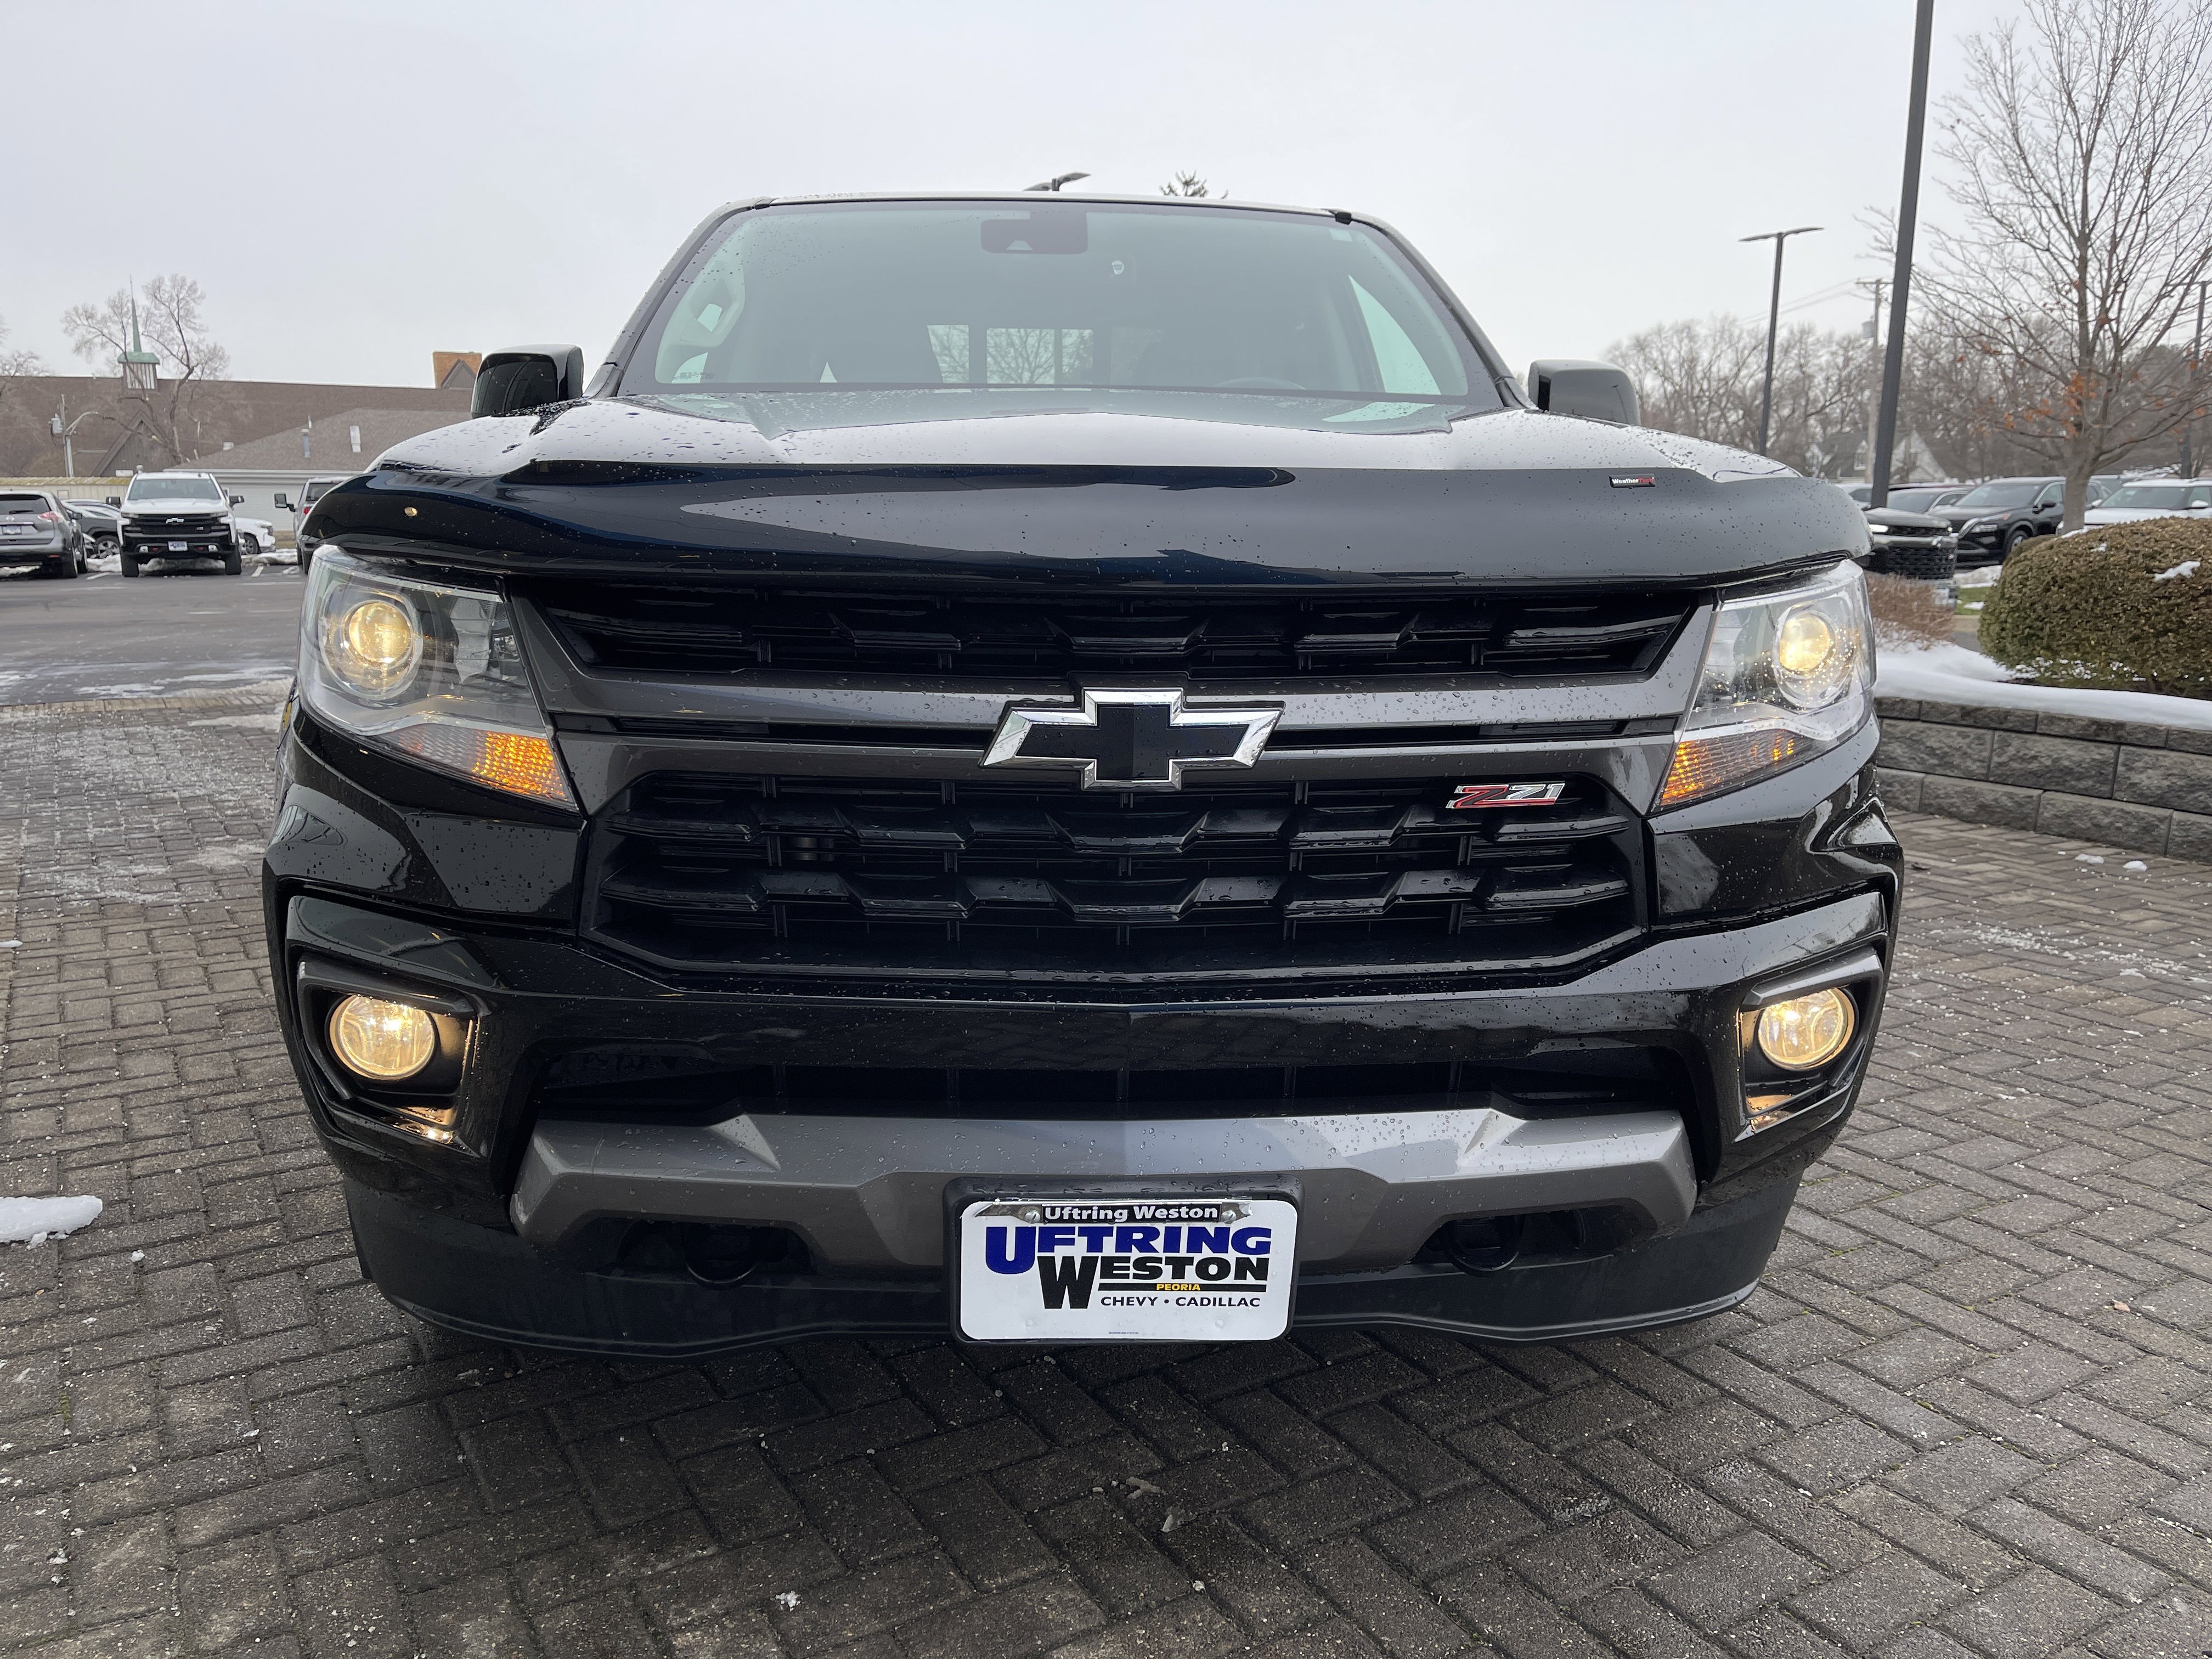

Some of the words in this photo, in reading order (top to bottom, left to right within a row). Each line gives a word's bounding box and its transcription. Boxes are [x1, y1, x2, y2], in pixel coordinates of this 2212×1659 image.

[1446, 782, 1565, 809] Z71
[1045, 1206, 1128, 1222] Uftring
[1133, 1205, 1217, 1219] Weston
[985, 1226, 1272, 1274] UFTRING
[1037, 1256, 1269, 1309] WESTON
[1101, 1296, 1158, 1306] CHEVY
[1175, 1296, 1260, 1307] CADILLAC
